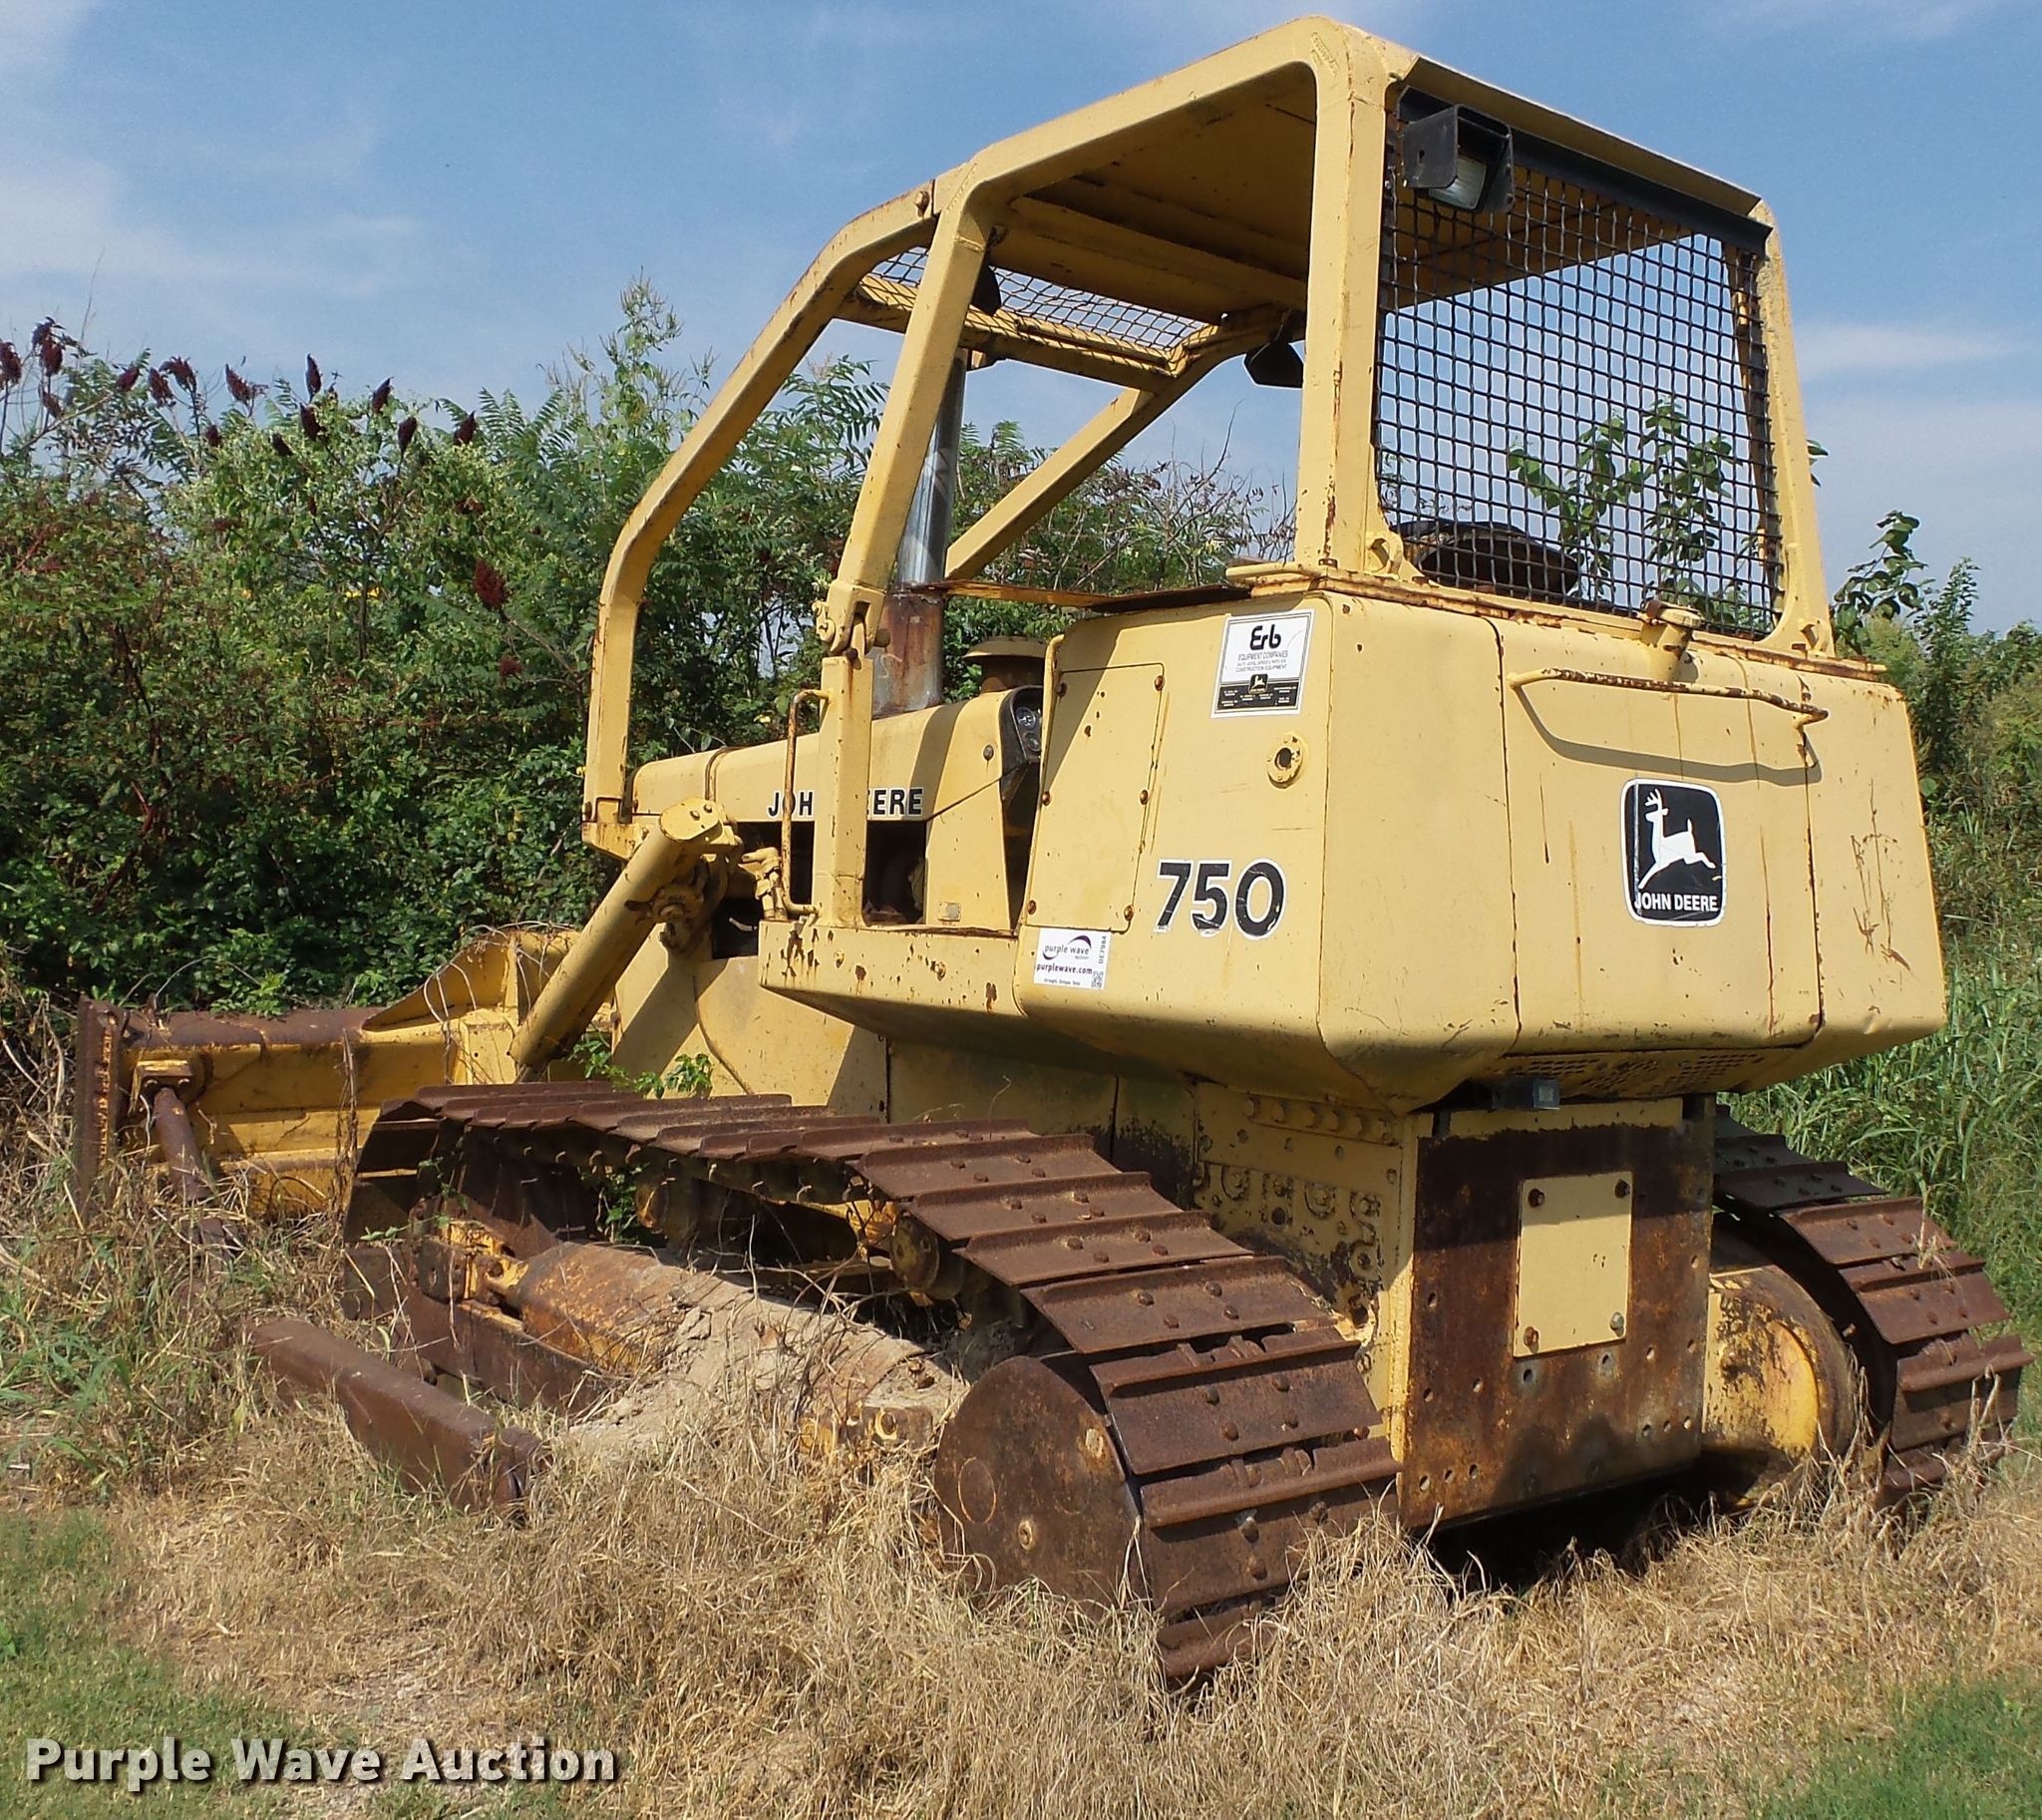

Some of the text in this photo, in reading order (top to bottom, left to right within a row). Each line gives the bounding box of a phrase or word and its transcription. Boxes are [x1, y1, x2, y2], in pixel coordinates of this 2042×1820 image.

[1249, 623, 1282, 650] Erb
[866, 787, 924, 816] ERE
[1156, 860, 1285, 938] 750
[1634, 892, 1719, 912] JOHN DEERE
[1044, 943, 1090, 955] purple wave
[1036, 962, 1093, 975] purplewave.com
